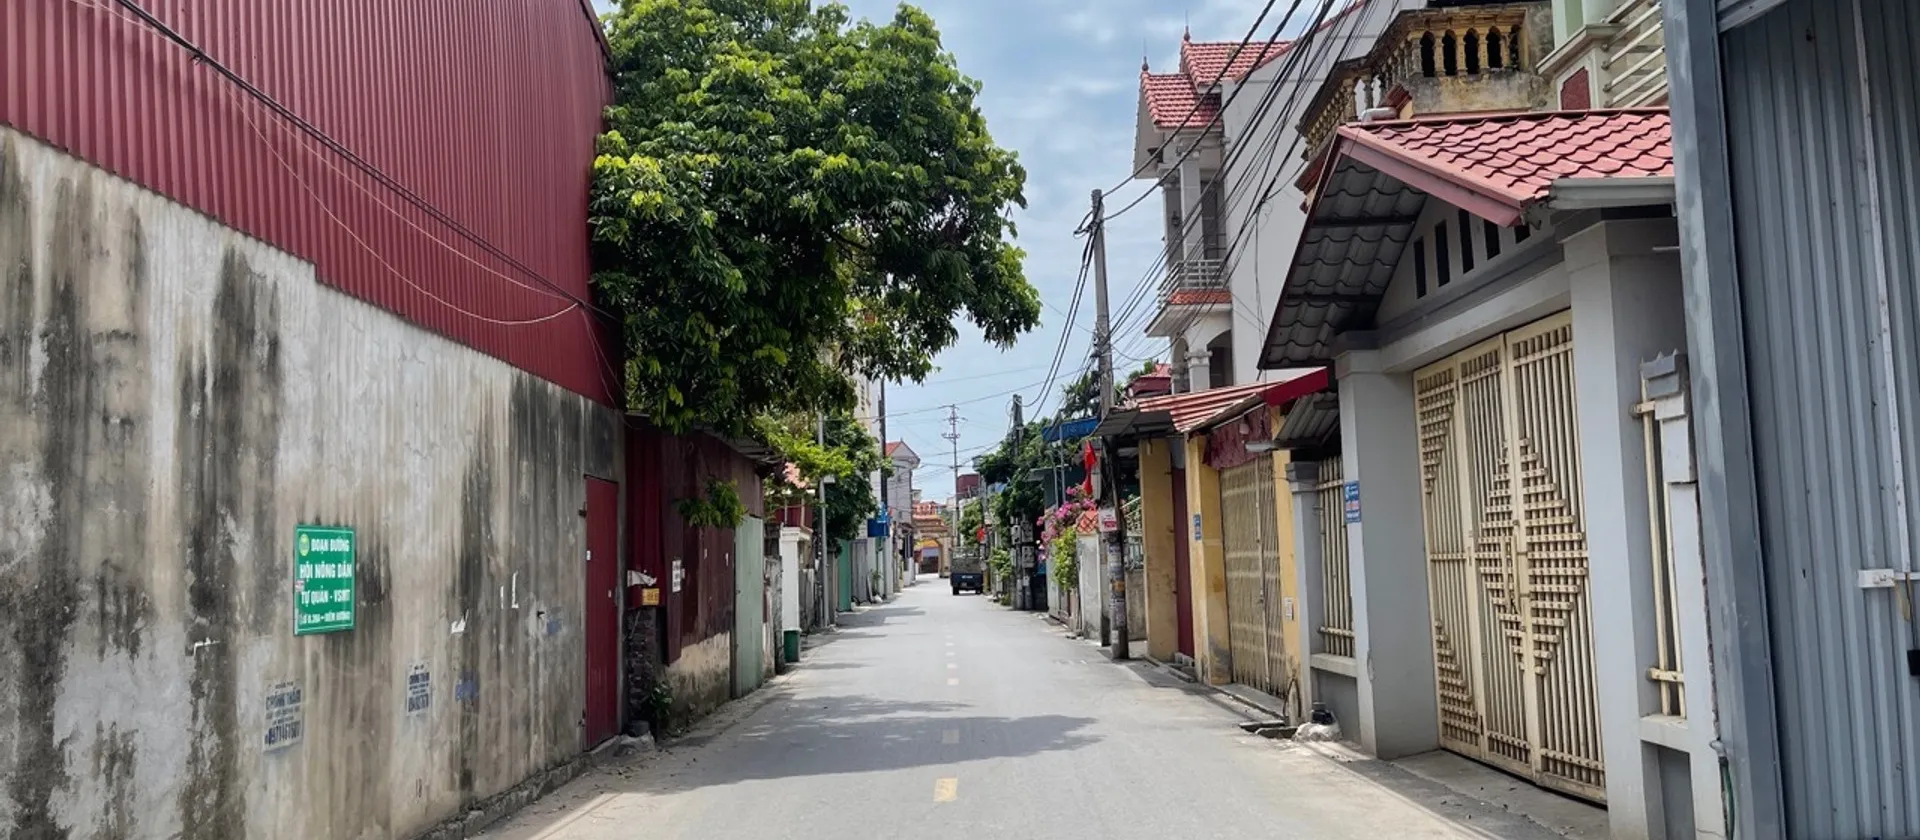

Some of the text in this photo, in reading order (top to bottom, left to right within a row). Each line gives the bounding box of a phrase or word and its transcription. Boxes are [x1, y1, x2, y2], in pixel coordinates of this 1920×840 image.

[300, 561, 352, 582] HỘI NÔNG DÂN
